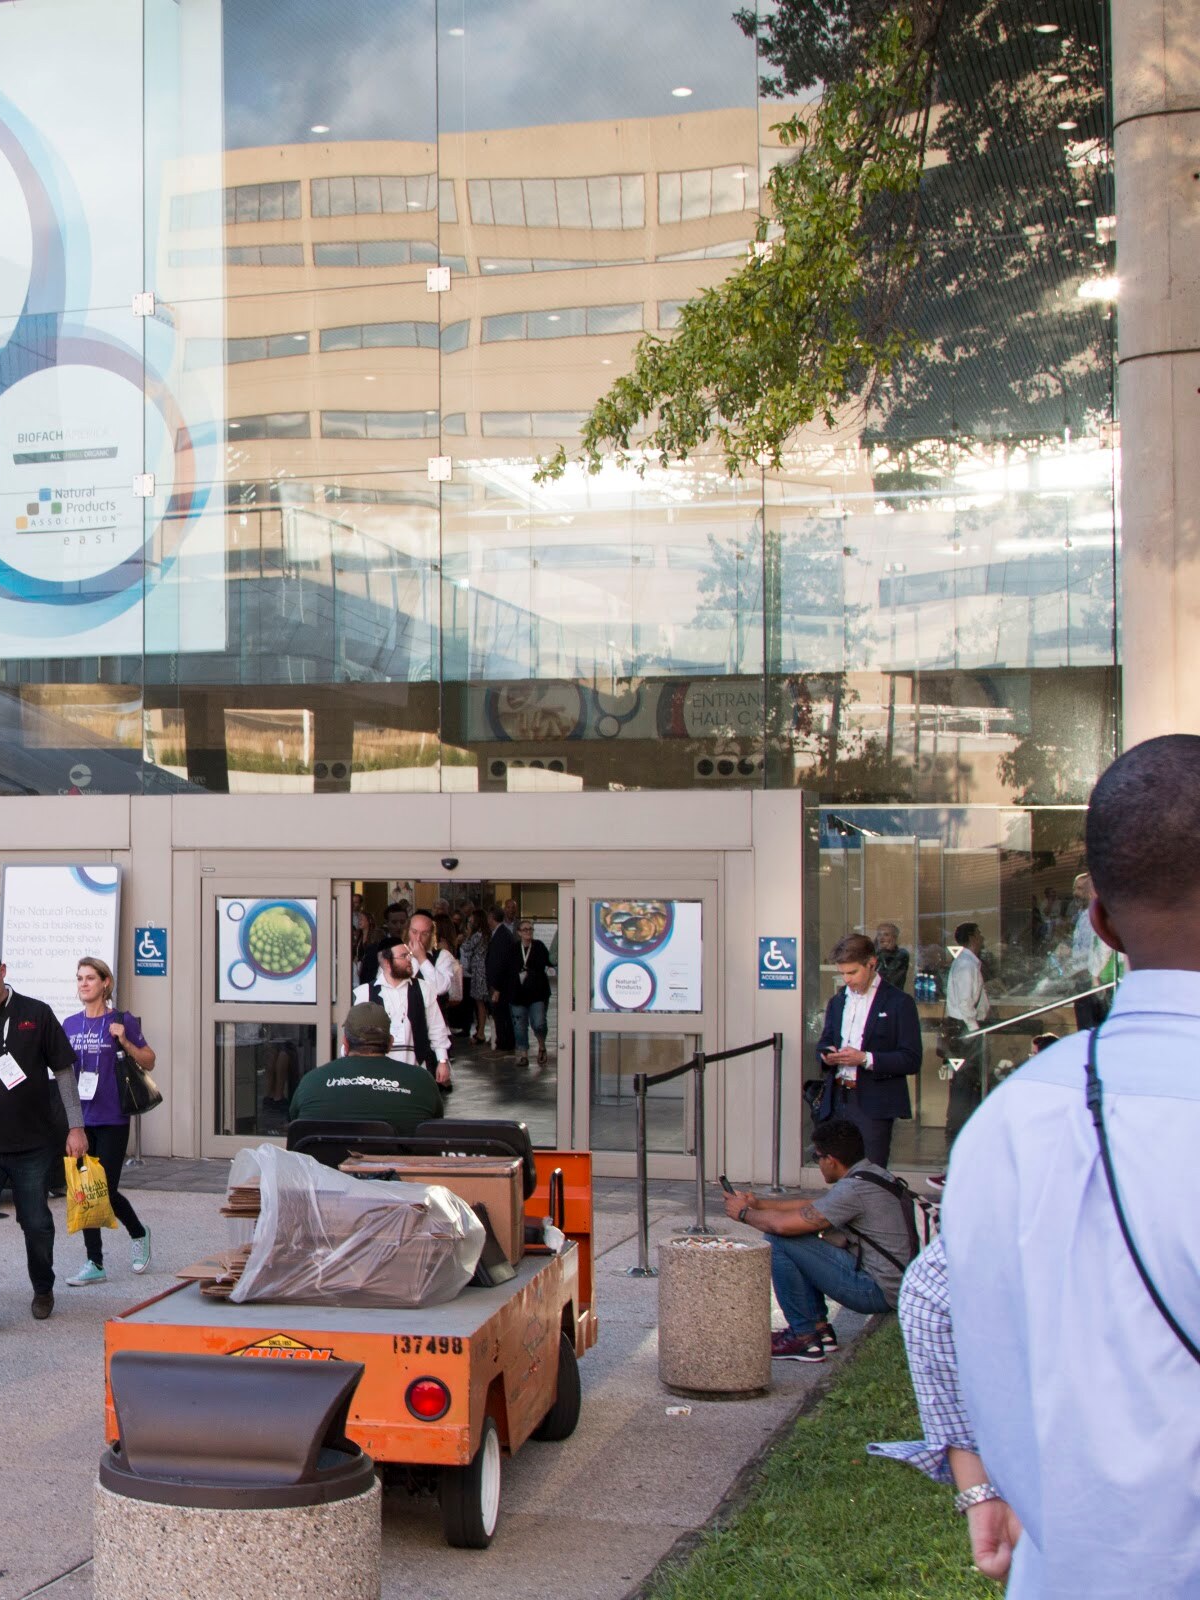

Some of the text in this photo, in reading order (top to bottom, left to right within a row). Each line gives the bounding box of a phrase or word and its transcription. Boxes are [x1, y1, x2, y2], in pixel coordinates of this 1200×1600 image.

[17, 430, 63, 444] BIOFACH
[84, 449, 110, 458] ORGANIC
[54, 486, 96, 500] Natural
[66, 500, 117, 514] Products
[30, 516, 117, 528] ASSOCIATION
[63, 532, 117, 546] east
[692, 710, 732, 726] HALL
[8, 906, 108, 916] The Natural Products
[7, 920, 30, 931] Expo
[33, 920, 40, 929] is
[51, 920, 92, 930] business
[95, 921, 104, 930] to
[6, 934, 103, 943] business trade show
[6, 947, 101, 959] and not open to the
[372, 1085, 411, 1095] Companies
